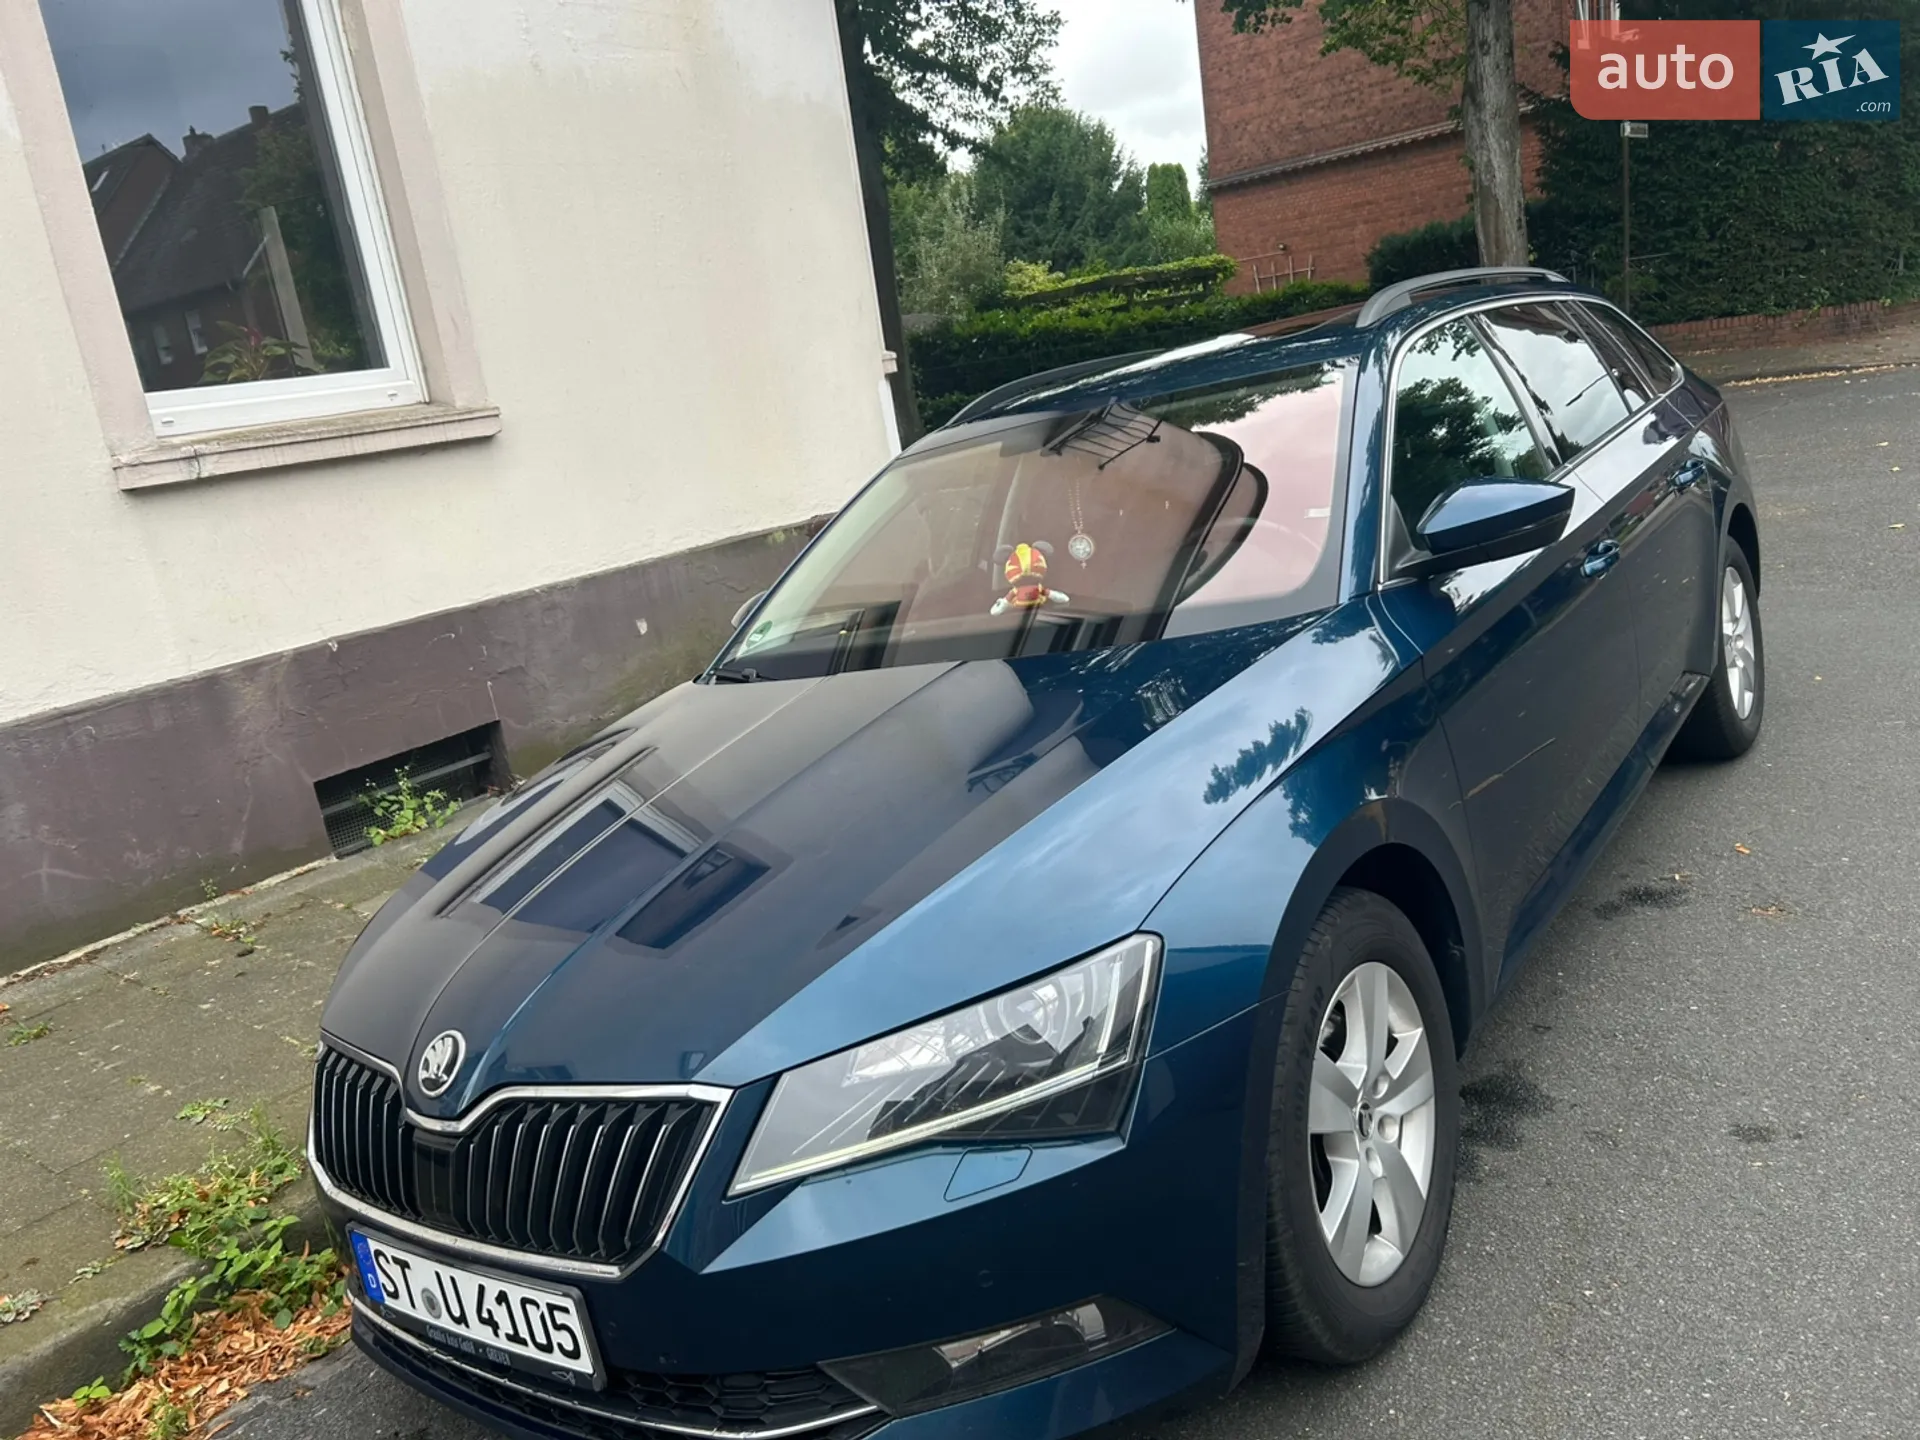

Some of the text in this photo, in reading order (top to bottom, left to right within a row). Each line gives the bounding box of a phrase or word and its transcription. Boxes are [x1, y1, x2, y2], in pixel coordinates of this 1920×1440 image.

[368, 1273, 377, 1289] D
[374, 1249, 417, 1310] ST
[434, 1270, 471, 1330] U
[476, 1282, 581, 1360] 4105
